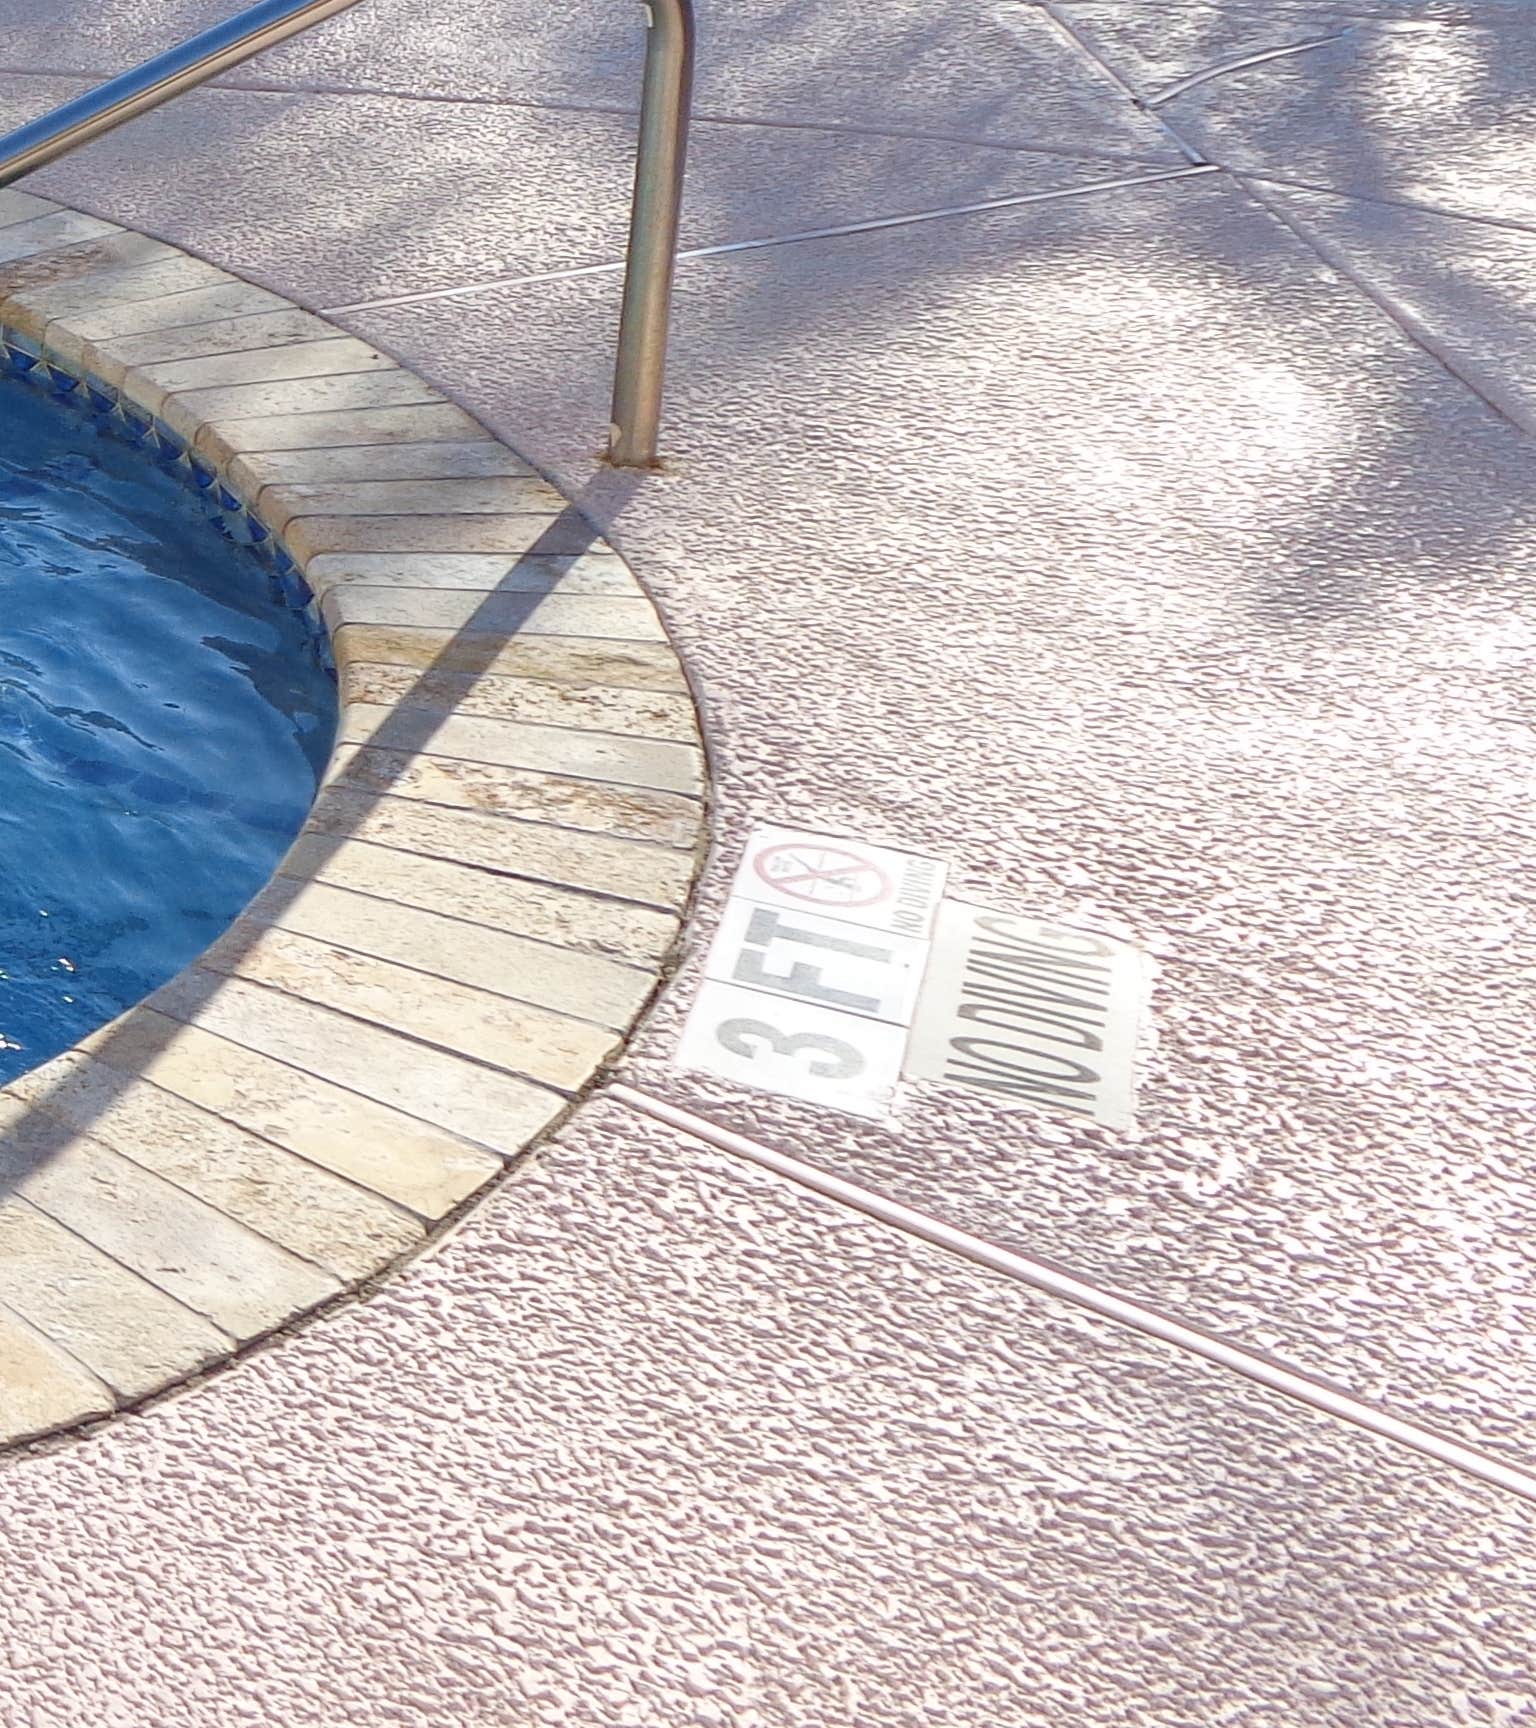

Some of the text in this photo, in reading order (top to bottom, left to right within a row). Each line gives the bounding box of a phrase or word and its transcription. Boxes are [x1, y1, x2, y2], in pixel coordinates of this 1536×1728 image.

[889, 858, 937, 934] NO DIVING
[714, 906, 896, 1080] 3 FT
[942, 915, 1116, 1117] NO DIVING
